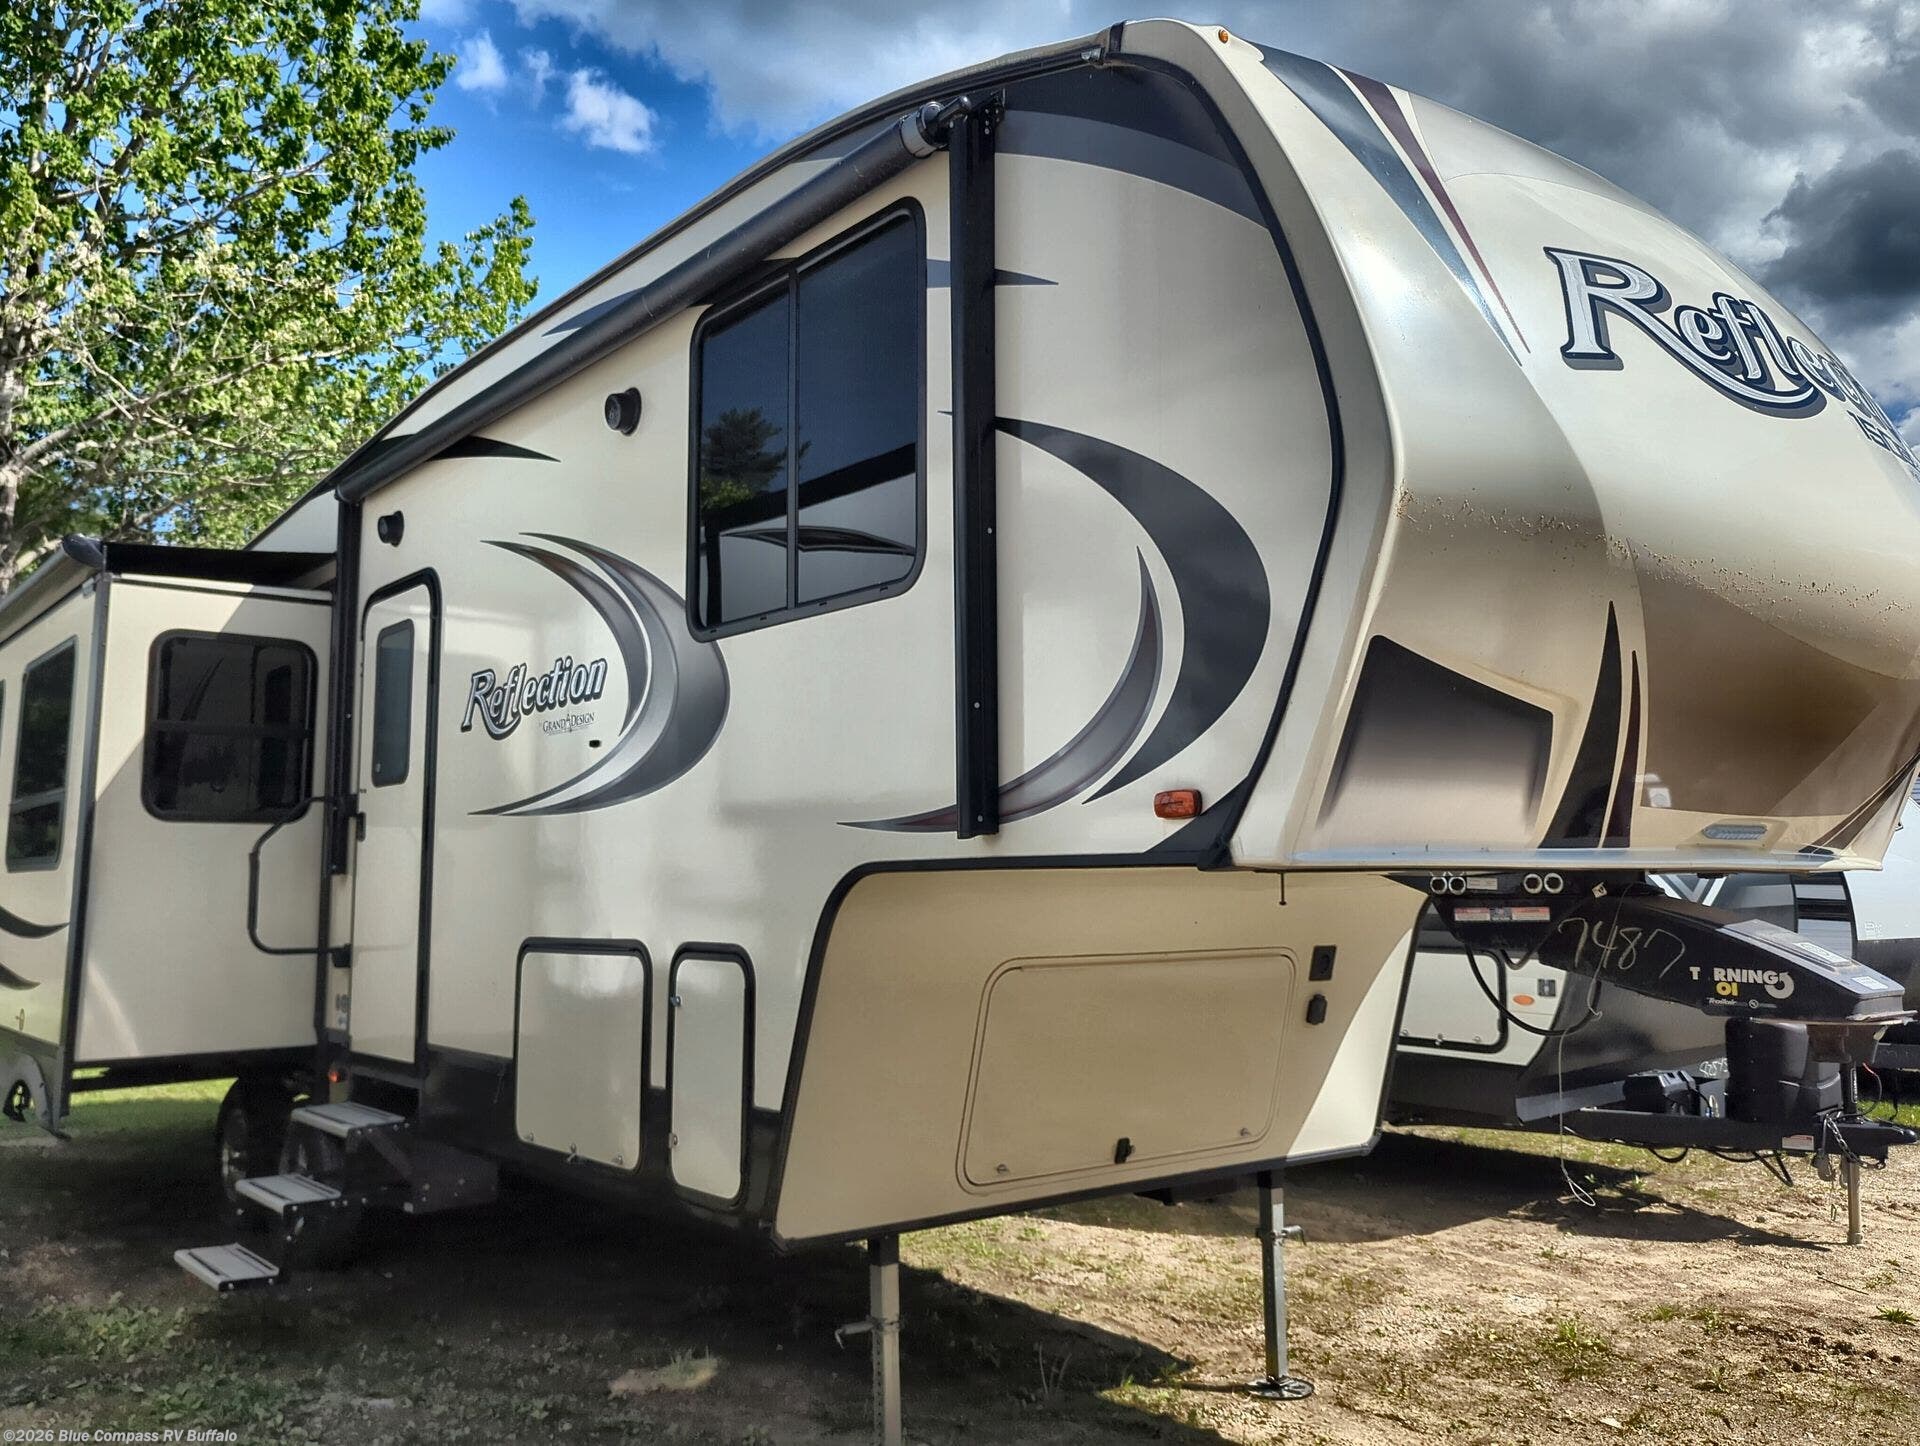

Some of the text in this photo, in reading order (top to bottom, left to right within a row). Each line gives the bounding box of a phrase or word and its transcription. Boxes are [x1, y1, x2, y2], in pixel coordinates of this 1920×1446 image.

[461, 656, 607, 741] Reflection
[543, 711, 595, 732] GRAND DESIGN
[1558, 917, 1686, 979] 7487
[1689, 966, 1779, 985] TRNING
